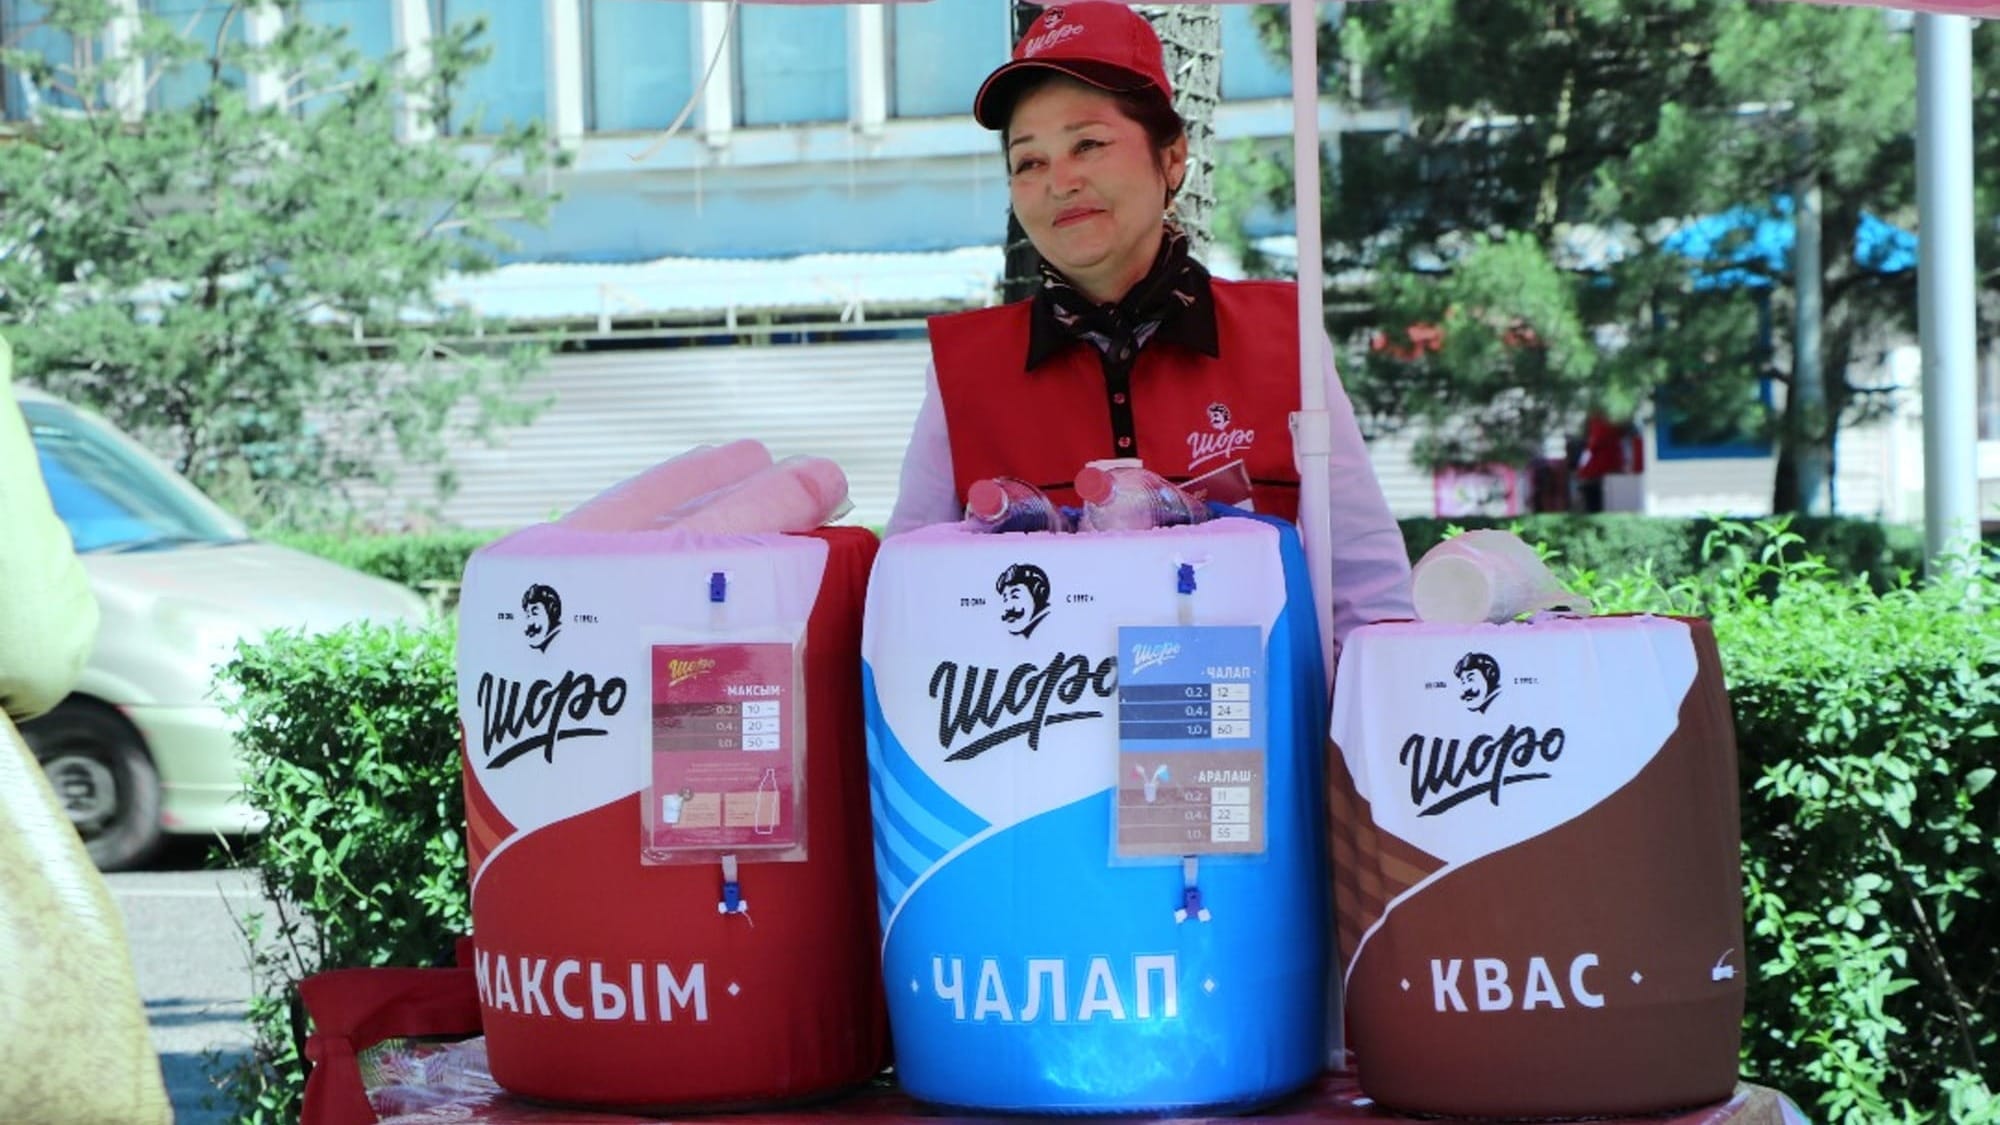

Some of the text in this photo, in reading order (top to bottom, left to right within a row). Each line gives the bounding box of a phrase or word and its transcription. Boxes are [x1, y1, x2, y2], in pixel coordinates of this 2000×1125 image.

[1186, 428, 1255, 471] Шоро
[1207, 666, 1250, 679] ЧАЛАП
[727, 684, 781, 697] МАКСЫМ
[1217, 687, 1229, 698] 12
[747, 704, 760, 714] 10
[1217, 705, 1231, 717] 24
[478, 670, 628, 769] Шоро
[748, 721, 762, 731] 20
[1217, 724, 1232, 735] 60
[746, 738, 763, 748] 50
[1198, 770, 1251, 783] АРАЛАШ
[1400, 724, 1565, 817] Шоро
[1217, 791, 1227, 801] 11
[1217, 809, 1231, 820] 22
[1216, 828, 1231, 839] 55
[475, 947, 708, 1022] МАКСЫМ
[932, 954, 1178, 1022] ЧАЛАП
[1430, 952, 1605, 1013] КВАС
